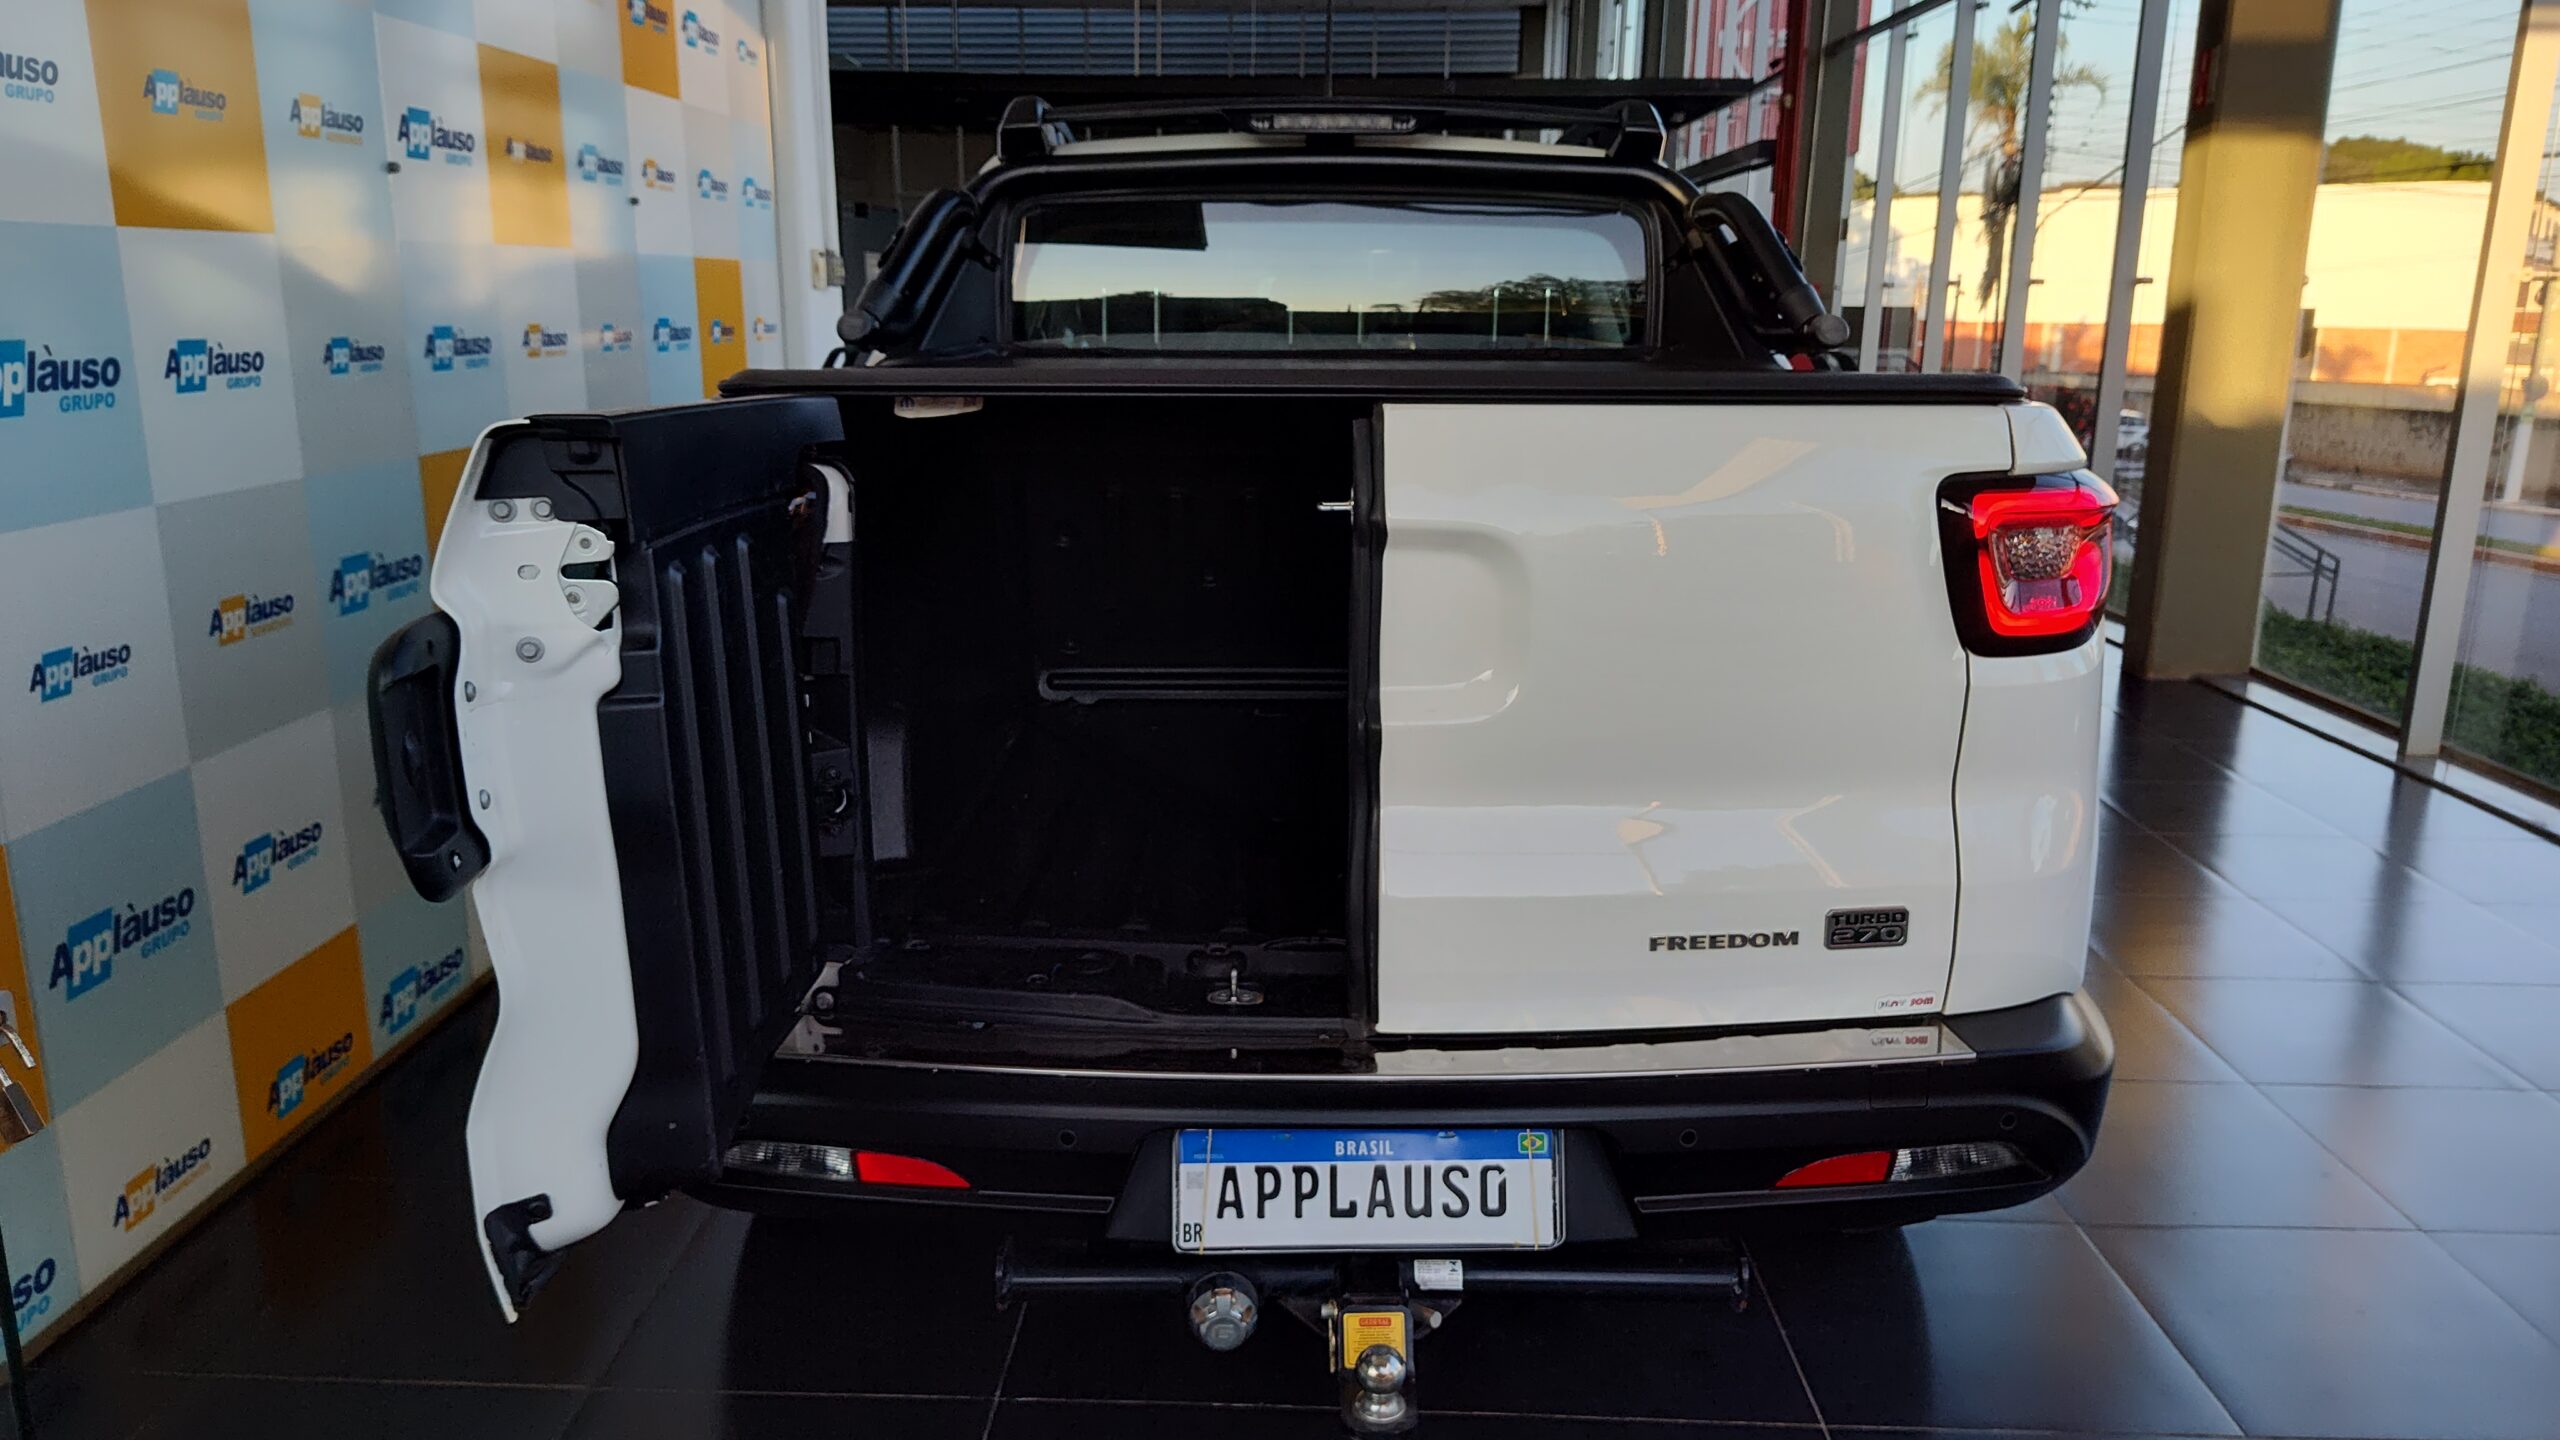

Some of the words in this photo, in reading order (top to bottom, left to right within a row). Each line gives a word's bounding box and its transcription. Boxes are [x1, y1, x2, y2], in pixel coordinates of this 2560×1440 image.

[5, 83, 54, 104] GRUPO
[0, 344, 121, 407] plàuso
[60, 391, 116, 413] GRUPO
[30, 644, 131, 695] Applàuso
[1831, 911, 1907, 926] TURBO
[49, 887, 195, 990] Applàuso
[141, 920, 191, 959] GRUPO
[1649, 931, 1799, 952] FREEDOM
[1832, 926, 1905, 945] 270
[1334, 1140, 1395, 1157] BRASIL
[1216, 1164, 1508, 1220] APPLAUSO
[1182, 1222, 1204, 1244] BR
